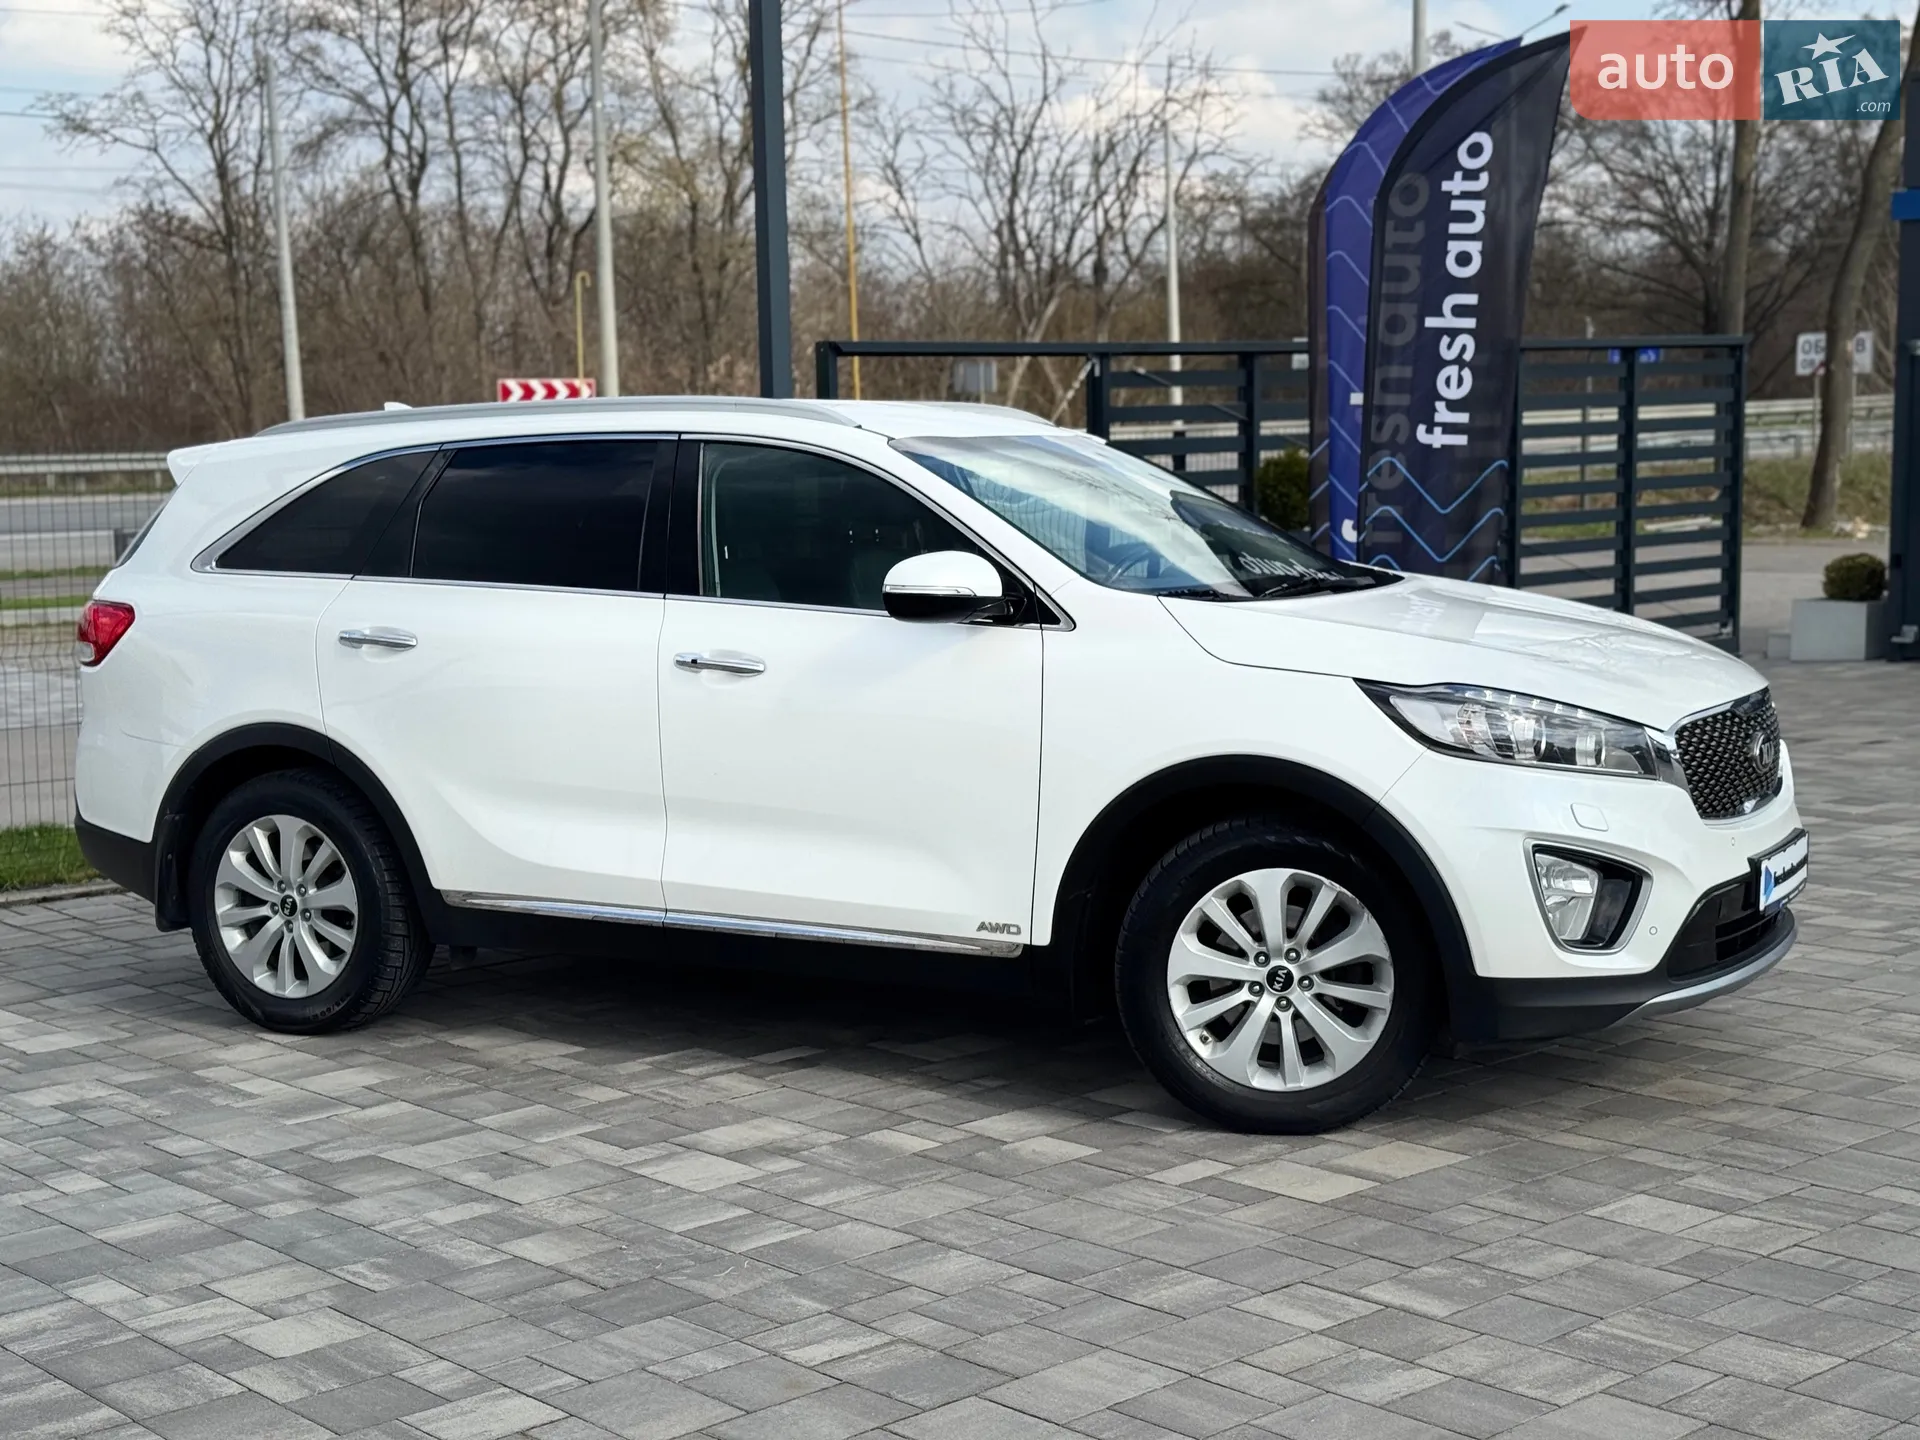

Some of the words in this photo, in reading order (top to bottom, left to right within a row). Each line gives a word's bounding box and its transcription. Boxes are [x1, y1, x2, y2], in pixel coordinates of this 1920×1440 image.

[1441, 130, 1494, 278] auto
[1416, 293, 1479, 449] fresh
[976, 921, 1022, 936] AWD
[1272, 970, 1287, 990] KIA
